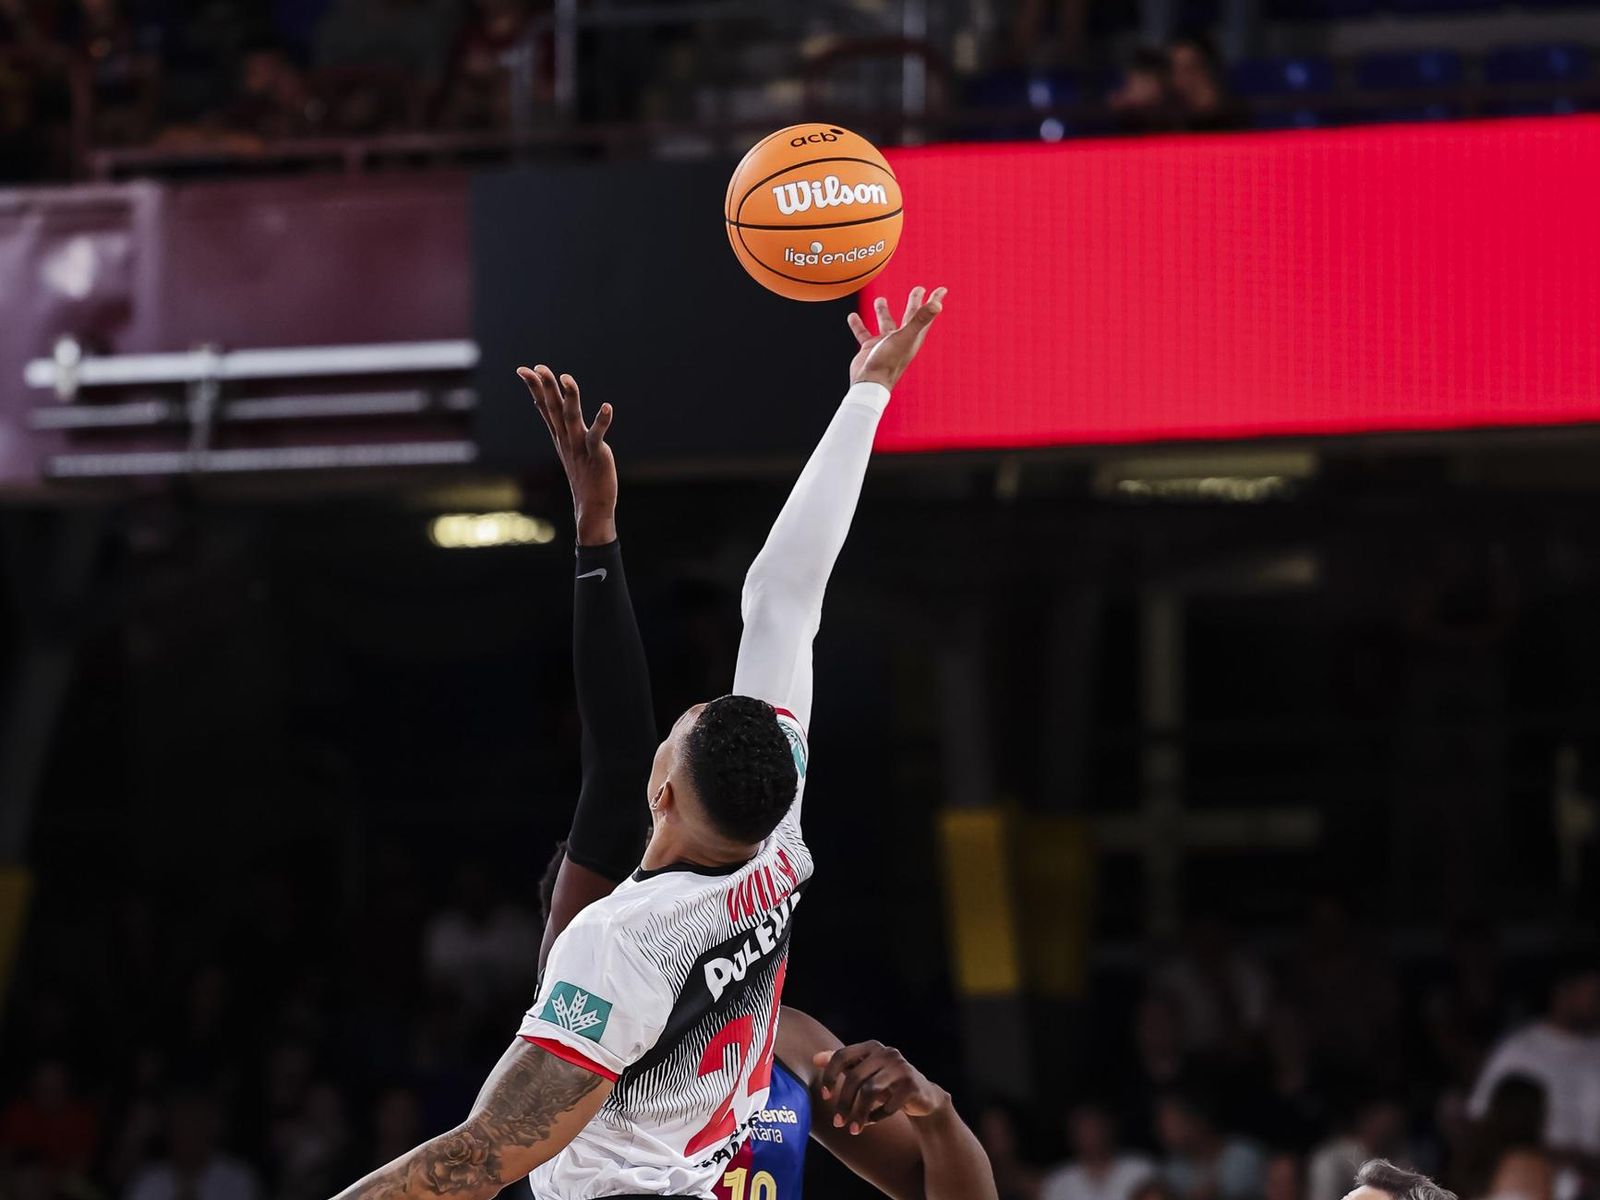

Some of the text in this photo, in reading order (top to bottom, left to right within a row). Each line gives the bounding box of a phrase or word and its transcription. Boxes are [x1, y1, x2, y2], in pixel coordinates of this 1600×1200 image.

[790, 131, 838, 148] acb
[772, 175, 888, 216] Wilson
[784, 240, 886, 266] liga endesa
